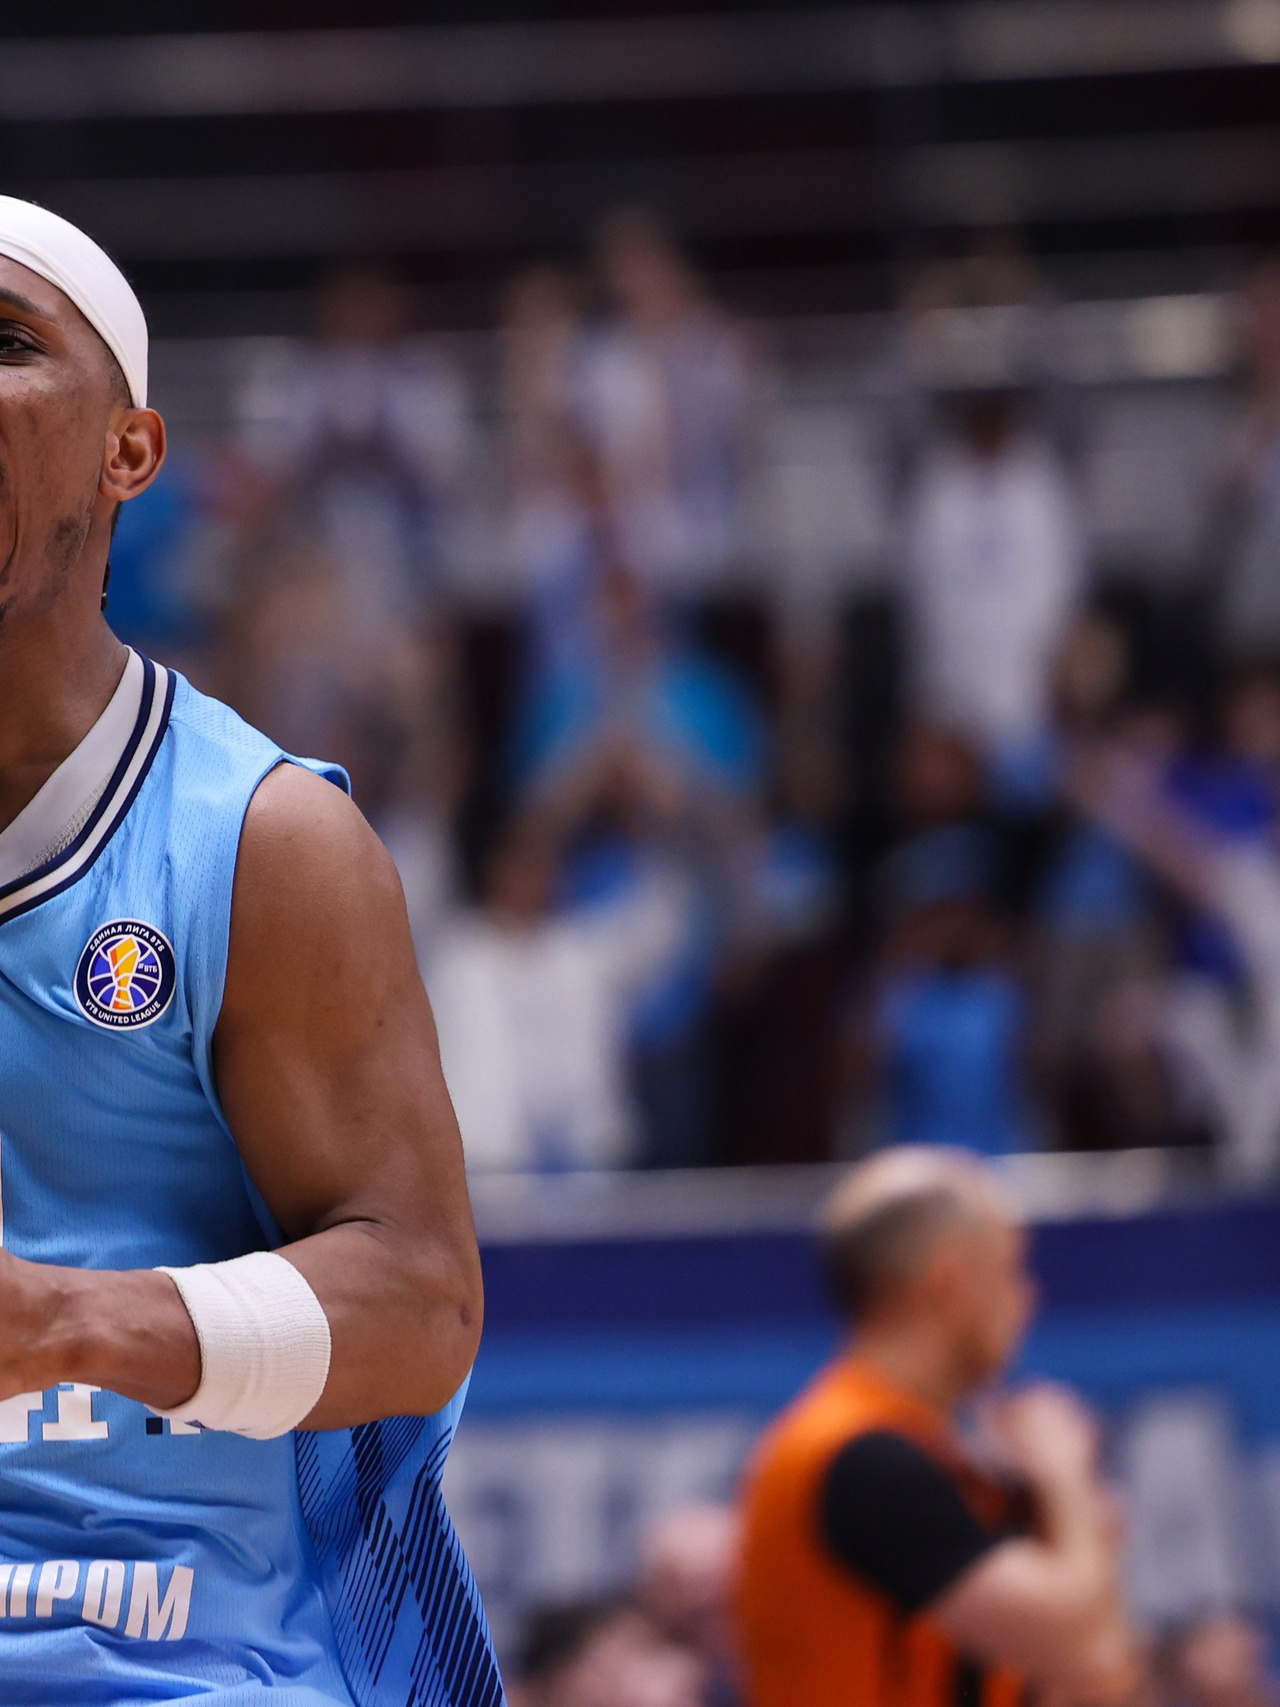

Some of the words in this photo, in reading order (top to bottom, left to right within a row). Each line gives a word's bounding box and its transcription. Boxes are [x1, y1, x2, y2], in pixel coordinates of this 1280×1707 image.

[89, 924, 123, 952] ЕДИНАЯ
[125, 924, 150, 939] ЛИГА
[150, 936, 165, 952] ВТБ
[85, 999, 98, 1015] VTB
[98, 1011, 129, 1024] UNITED
[131, 1000, 161, 1023] LEAGUE
